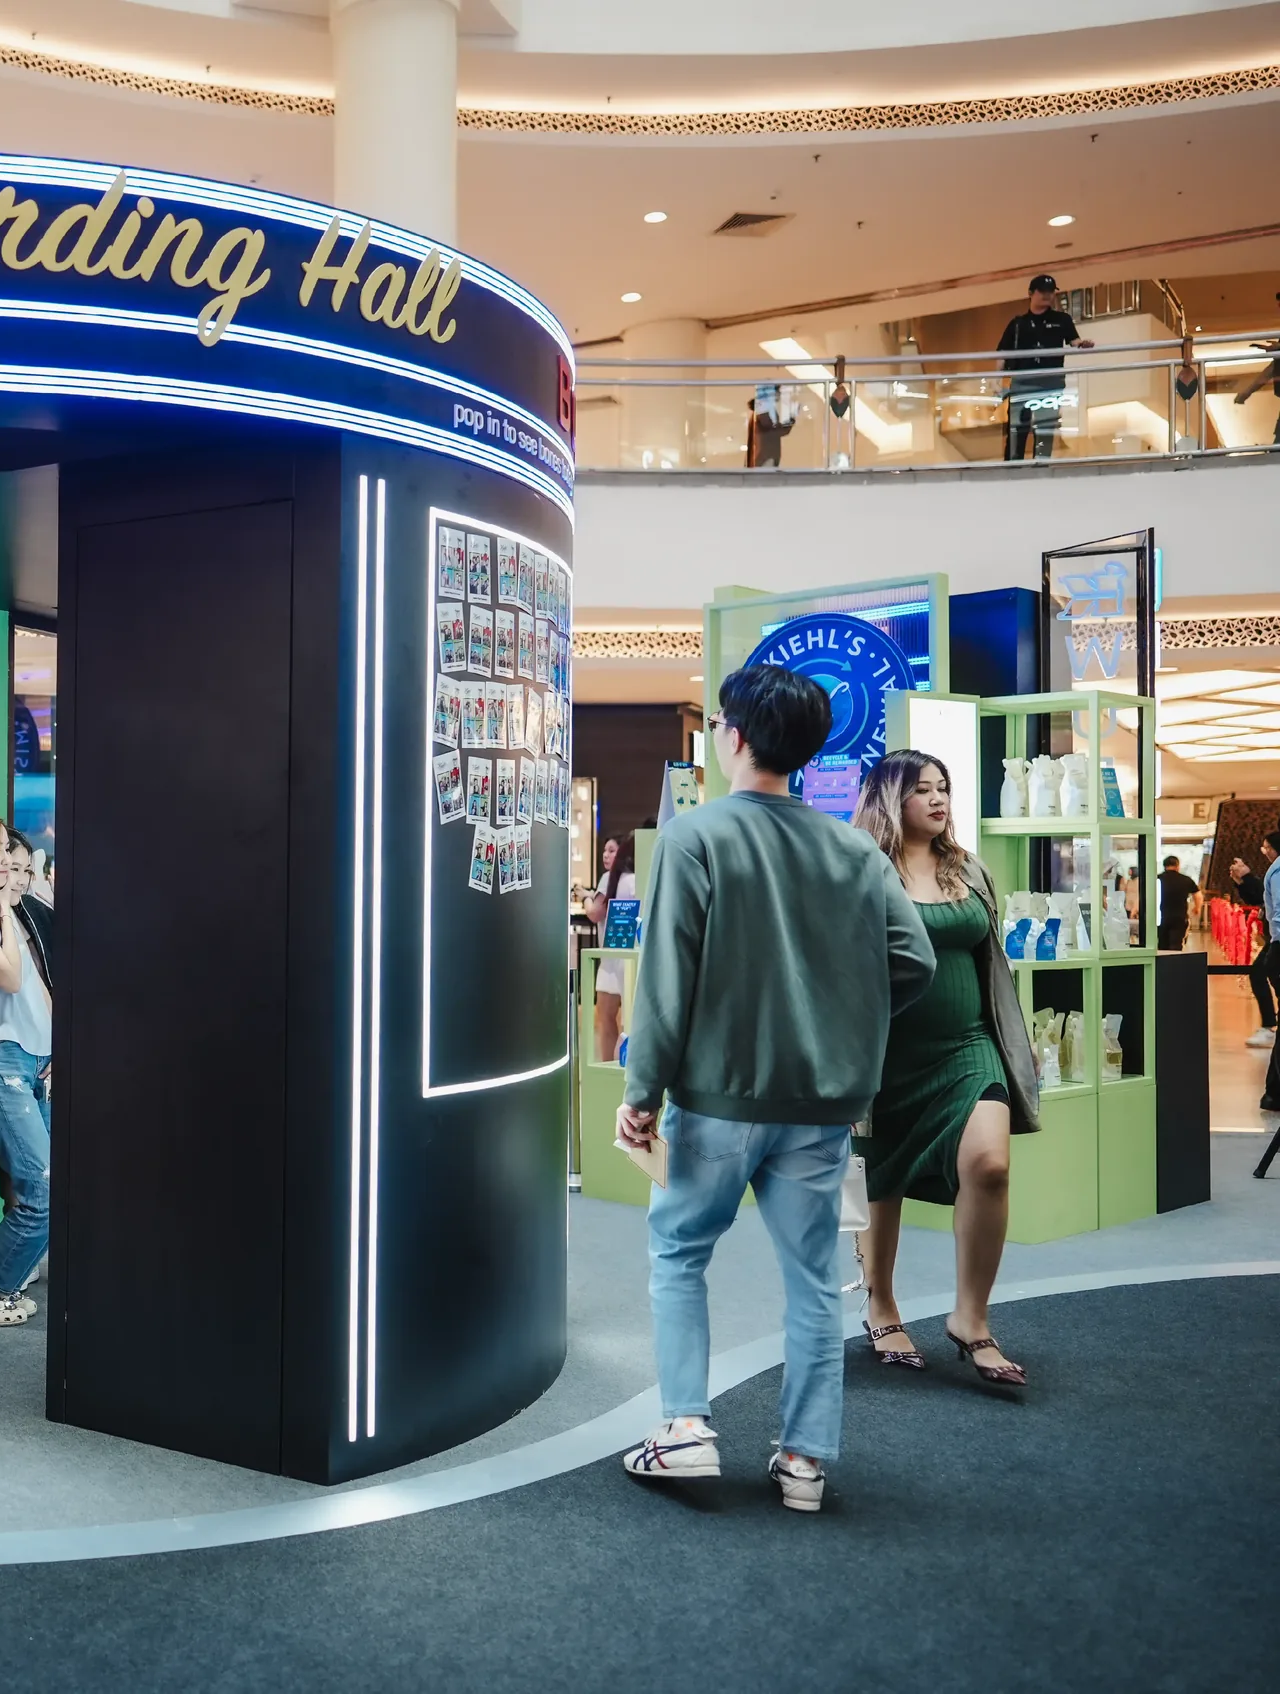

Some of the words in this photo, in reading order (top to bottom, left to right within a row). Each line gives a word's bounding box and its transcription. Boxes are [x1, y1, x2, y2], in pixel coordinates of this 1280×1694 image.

[299, 215, 462, 343] Hall
[453, 403, 484, 435] pop
[486, 410, 500, 437] in
[502, 418, 517, 444] to
[518, 431, 538, 456] see
[538, 437, 562, 475] bones
[762, 628, 866, 666] KIEHL'S
